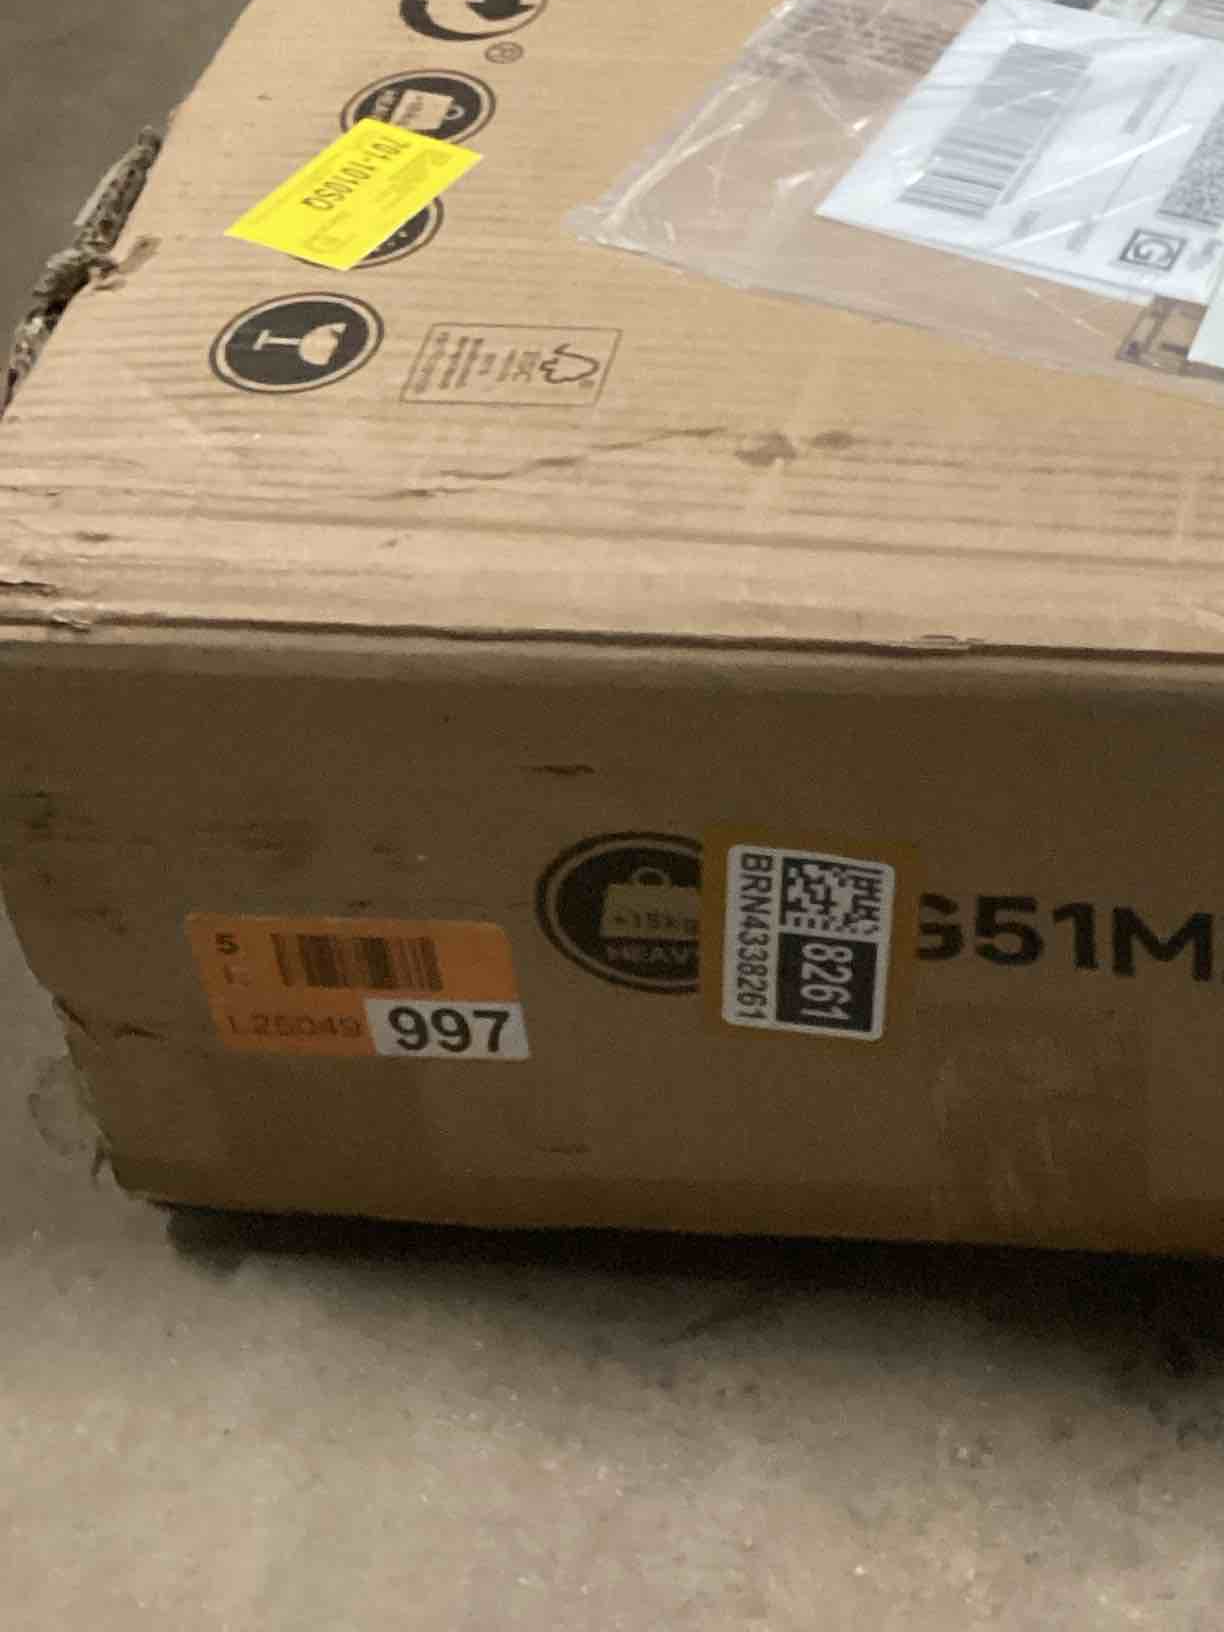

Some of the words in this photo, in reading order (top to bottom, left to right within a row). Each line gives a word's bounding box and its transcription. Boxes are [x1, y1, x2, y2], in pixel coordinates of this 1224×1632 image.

[736, 852, 774, 1019] BRN4338261
[801, 942, 854, 1021] 8261
[387, 1005, 511, 1053] 997
